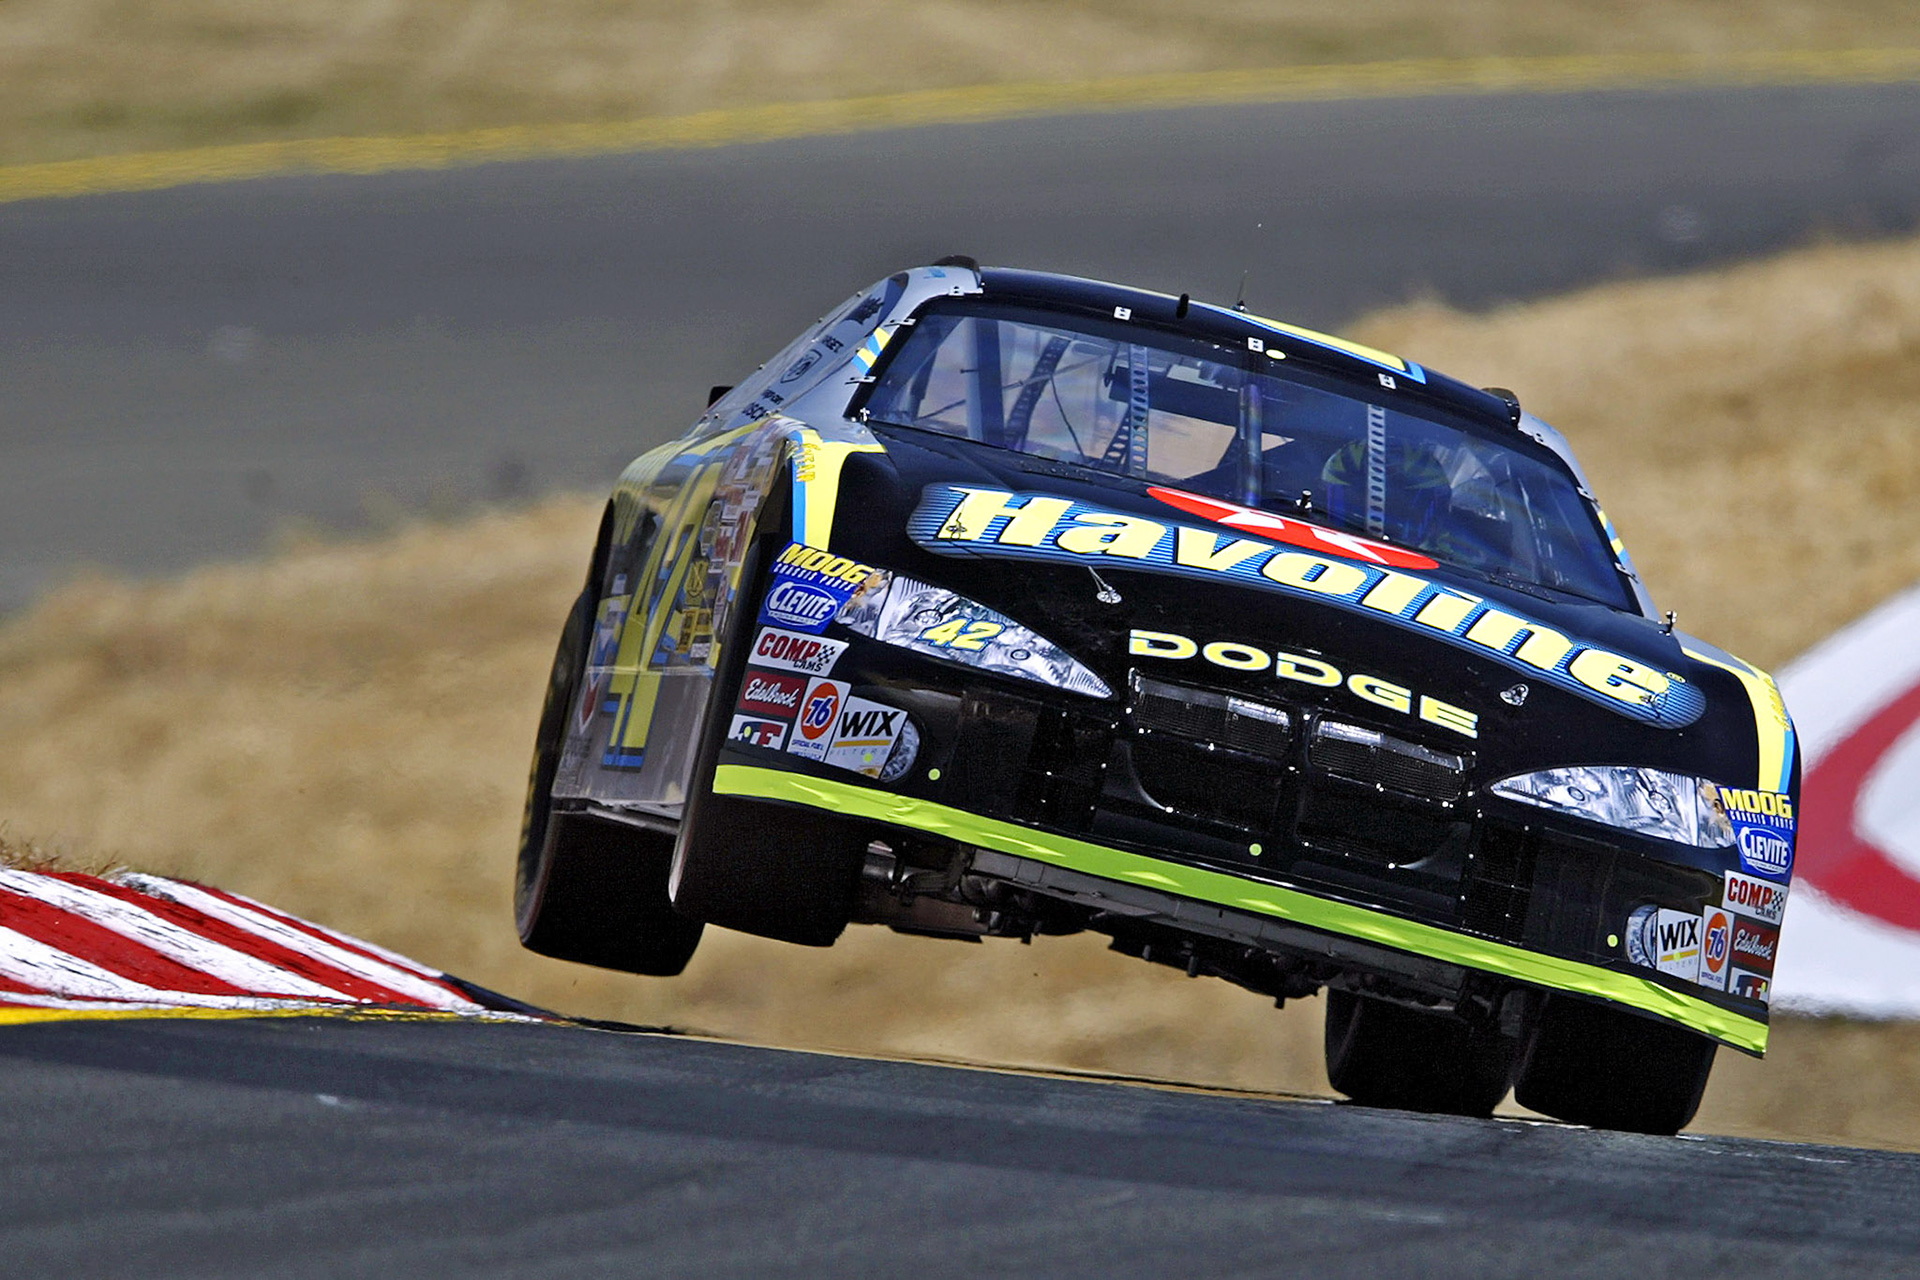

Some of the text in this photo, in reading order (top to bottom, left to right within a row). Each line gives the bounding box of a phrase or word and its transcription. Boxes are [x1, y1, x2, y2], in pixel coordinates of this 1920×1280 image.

[773, 563, 857, 591] CHASSIS PARTS
[776, 543, 875, 584] MOOG
[769, 581, 837, 619] CLEVITE
[936, 485, 1674, 714] Havoline
[757, 633, 821, 661] COMP
[920, 618, 1004, 651] 42
[793, 658, 823, 672] CAMS
[744, 679, 797, 708] Edelbrock
[1129, 629, 1479, 739] DODGE
[803, 694, 837, 728] 76
[840, 711, 899, 738] WIX
[1720, 787, 1792, 819] MOOG
[1730, 811, 1793, 830] CHASSIS PARTS
[1740, 826, 1788, 865] CLEVITE
[1727, 877, 1772, 908] COMP
[1756, 906, 1777, 920] CAMS
[1659, 918, 1699, 952] WIX
[1707, 926, 1726, 961] 76
